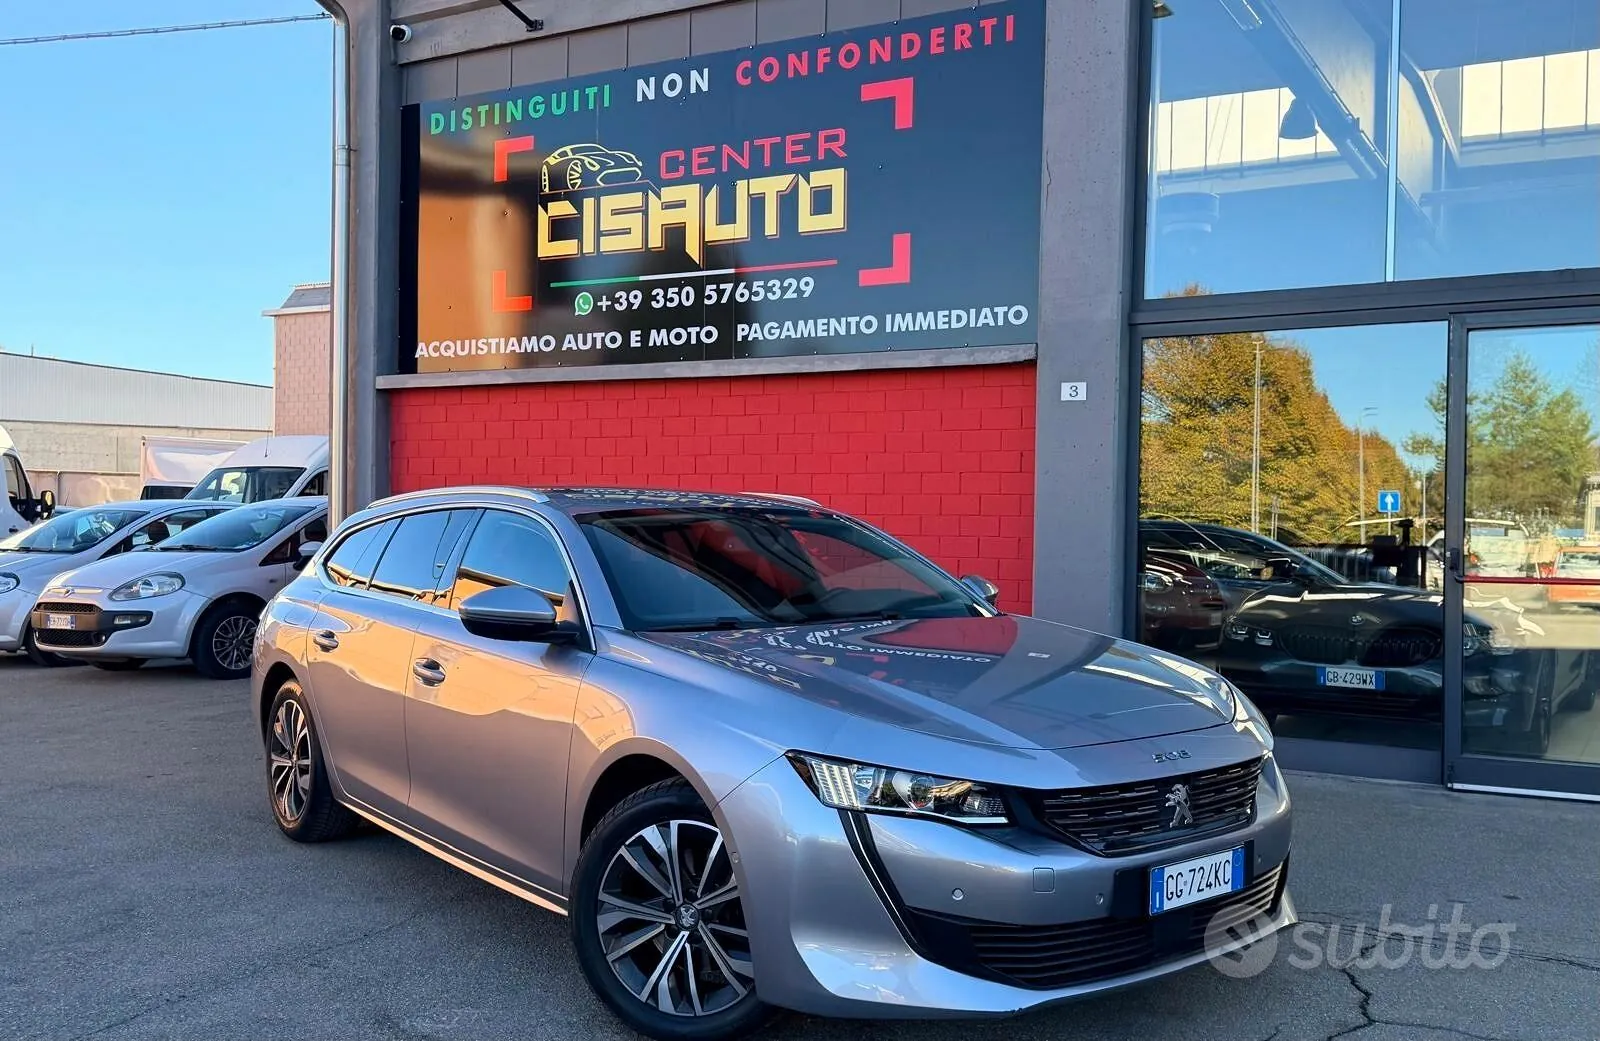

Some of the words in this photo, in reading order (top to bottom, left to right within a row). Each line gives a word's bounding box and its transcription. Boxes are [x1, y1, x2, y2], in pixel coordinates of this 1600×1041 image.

[430, 84, 611, 135] DISTINGUITI
[636, 68, 709, 101] NON
[735, 15, 1014, 86] CONFONDERTI
[660, 128, 847, 180] CENTER
[537, 167, 847, 268] CISAUTO
[597, 290, 642, 312] +39
[651, 286, 695, 308] 350
[704, 276, 815, 305] 5765329
[415, 334, 556, 358] ACQUISTIAMO
[561, 330, 622, 351] AUTO
[630, 329, 641, 348] E
[649, 325, 718, 347] MOTO
[737, 314, 878, 342] PAGAMENTO
[885, 304, 1029, 333] IMMEDIATO
[1069, 385, 1079, 397] 3
